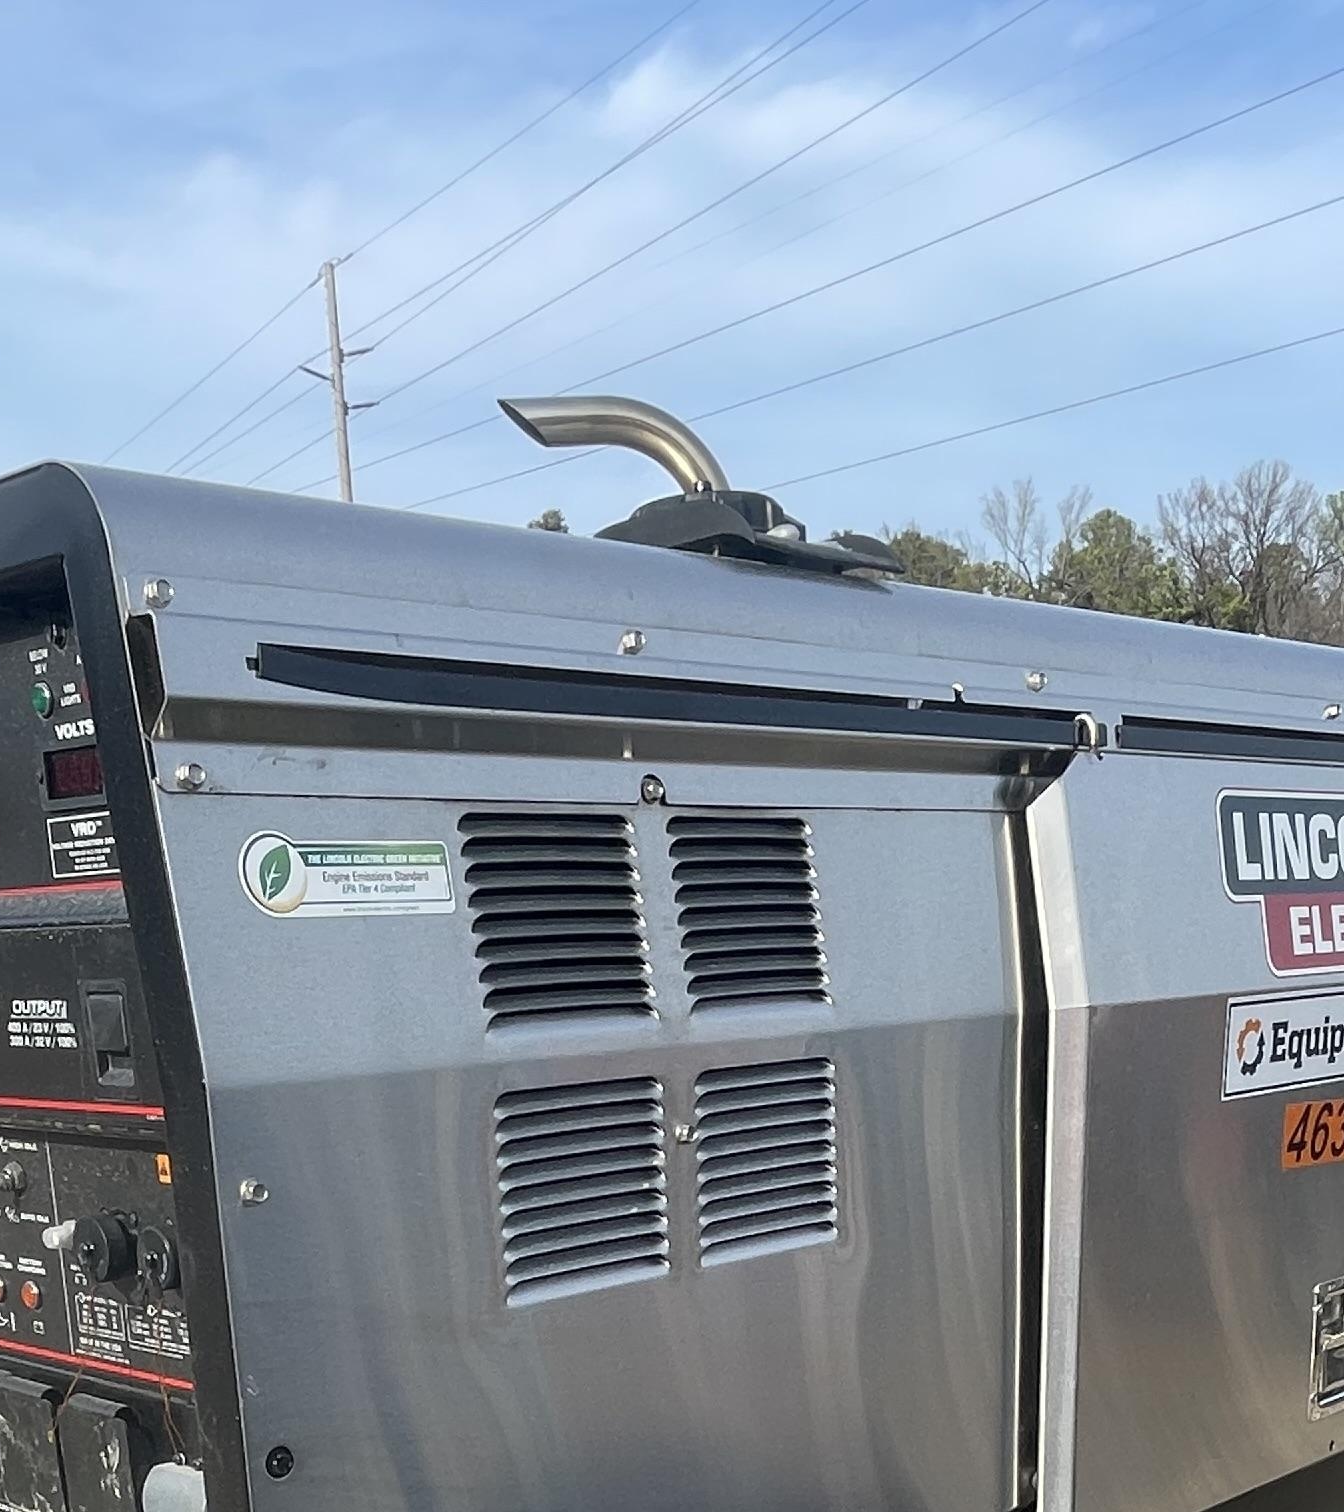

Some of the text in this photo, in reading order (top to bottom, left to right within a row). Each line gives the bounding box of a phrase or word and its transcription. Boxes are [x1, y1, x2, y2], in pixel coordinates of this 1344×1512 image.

[54, 718, 96, 740] VOLTS
[322, 854, 352, 864] LINCOLN
[353, 854, 385, 864] ELECTRIC
[322, 871, 430, 885] Engine Emissions Standard
[342, 883, 417, 895] EPA Tier 4 Compliant
[11, 1000, 64, 1016] OUTPUT
